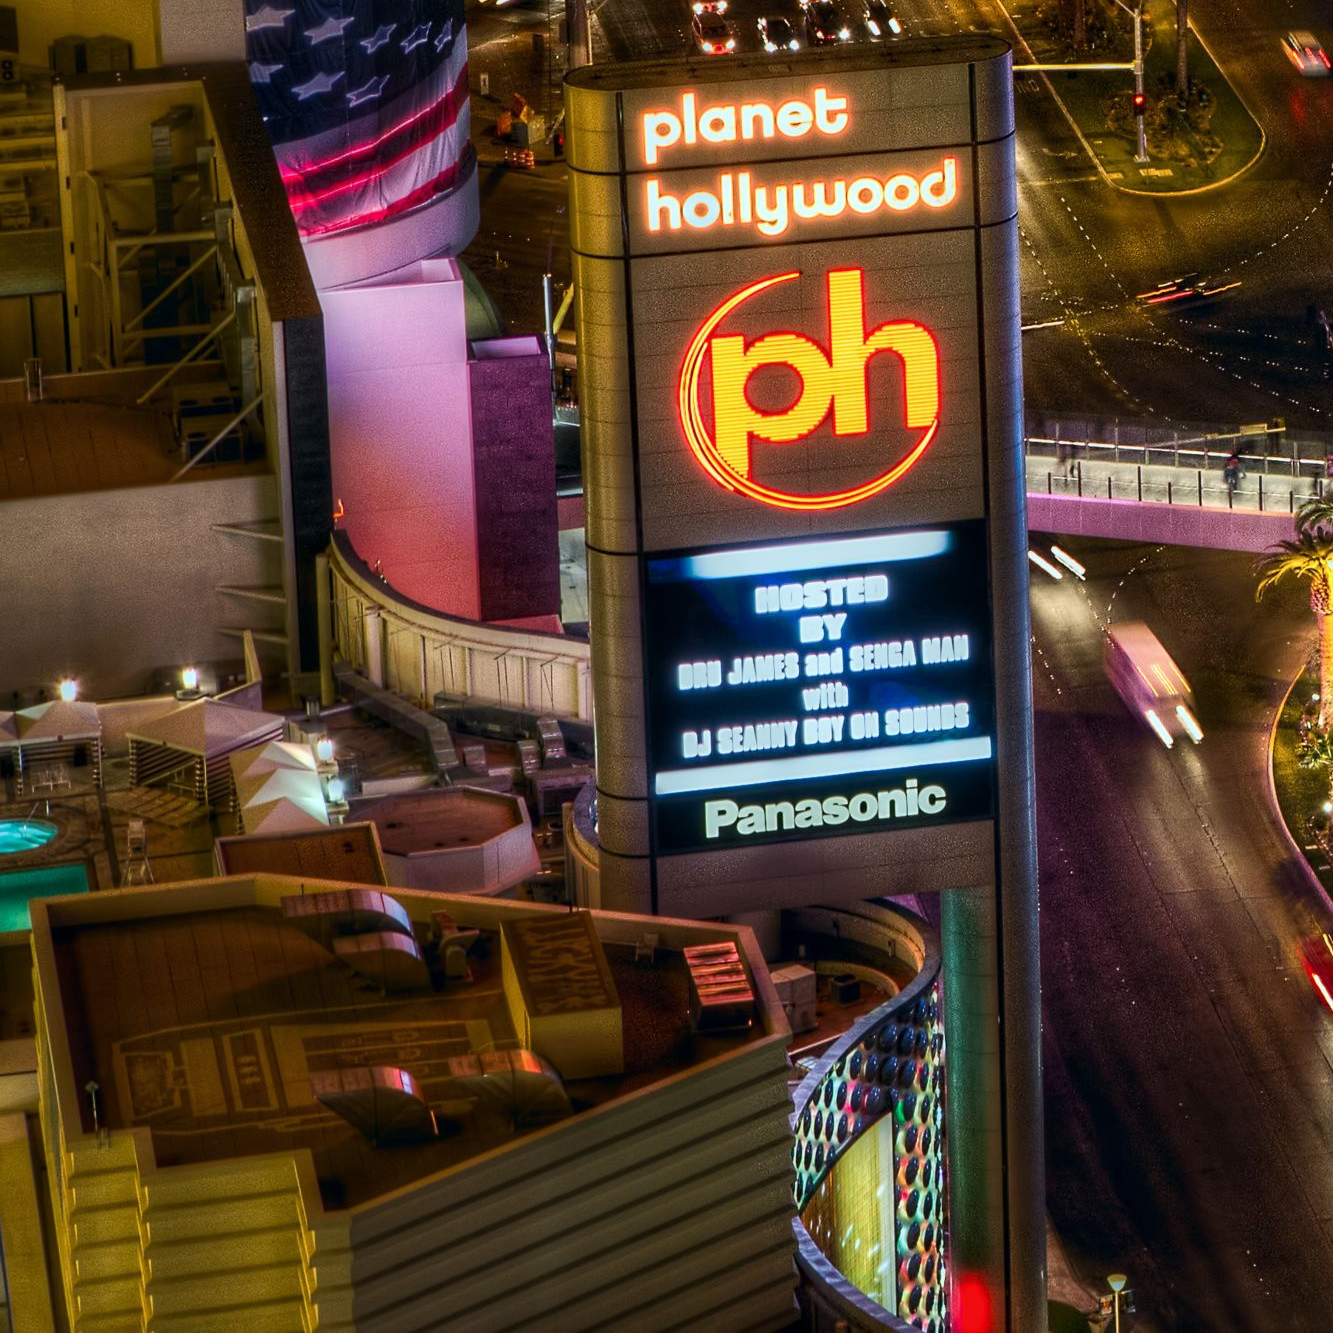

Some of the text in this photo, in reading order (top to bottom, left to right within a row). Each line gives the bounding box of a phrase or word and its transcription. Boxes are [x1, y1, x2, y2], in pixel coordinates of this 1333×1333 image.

[643, 86, 849, 165] planet
[645, 156, 959, 237] hollywood
[710, 267, 942, 480] ph
[755, 575, 889, 614] HOSTED
[799, 613, 848, 644] BY
[727, 651, 800, 686] JAMES
[804, 647, 844, 677] and
[921, 634, 970, 665] MAN
[802, 681, 849, 712] with
[682, 702, 970, 759] DJ SEANNY BOY ON SOUNDS
[704, 778, 947, 840] Panasonic
